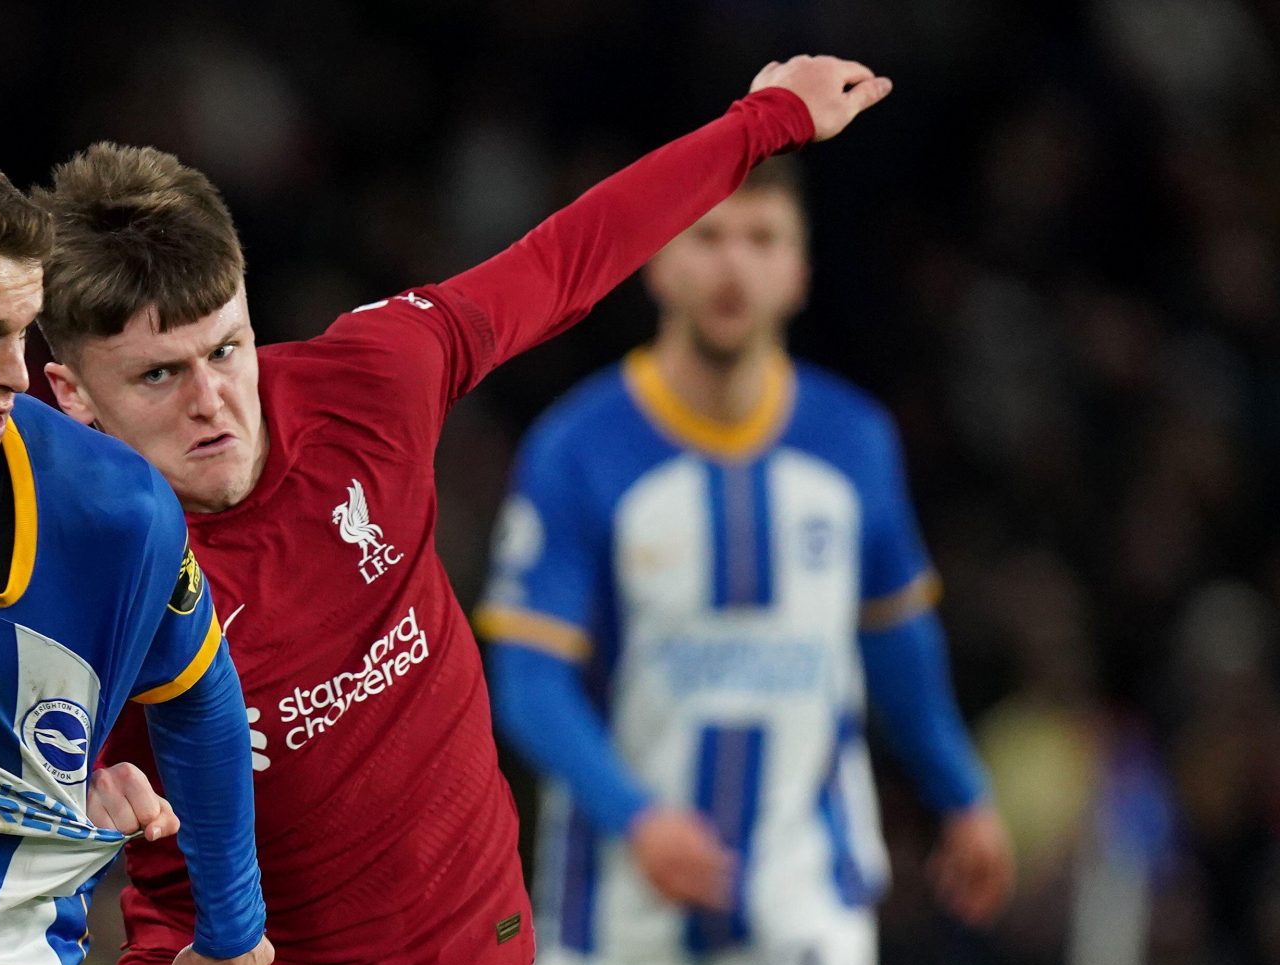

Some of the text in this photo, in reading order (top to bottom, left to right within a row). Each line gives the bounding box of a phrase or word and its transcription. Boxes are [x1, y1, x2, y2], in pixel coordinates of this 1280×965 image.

[285, 630, 429, 750] chartered
[34, 703, 72, 717] BRIGHTON
[43, 762, 71, 780] ALBION
